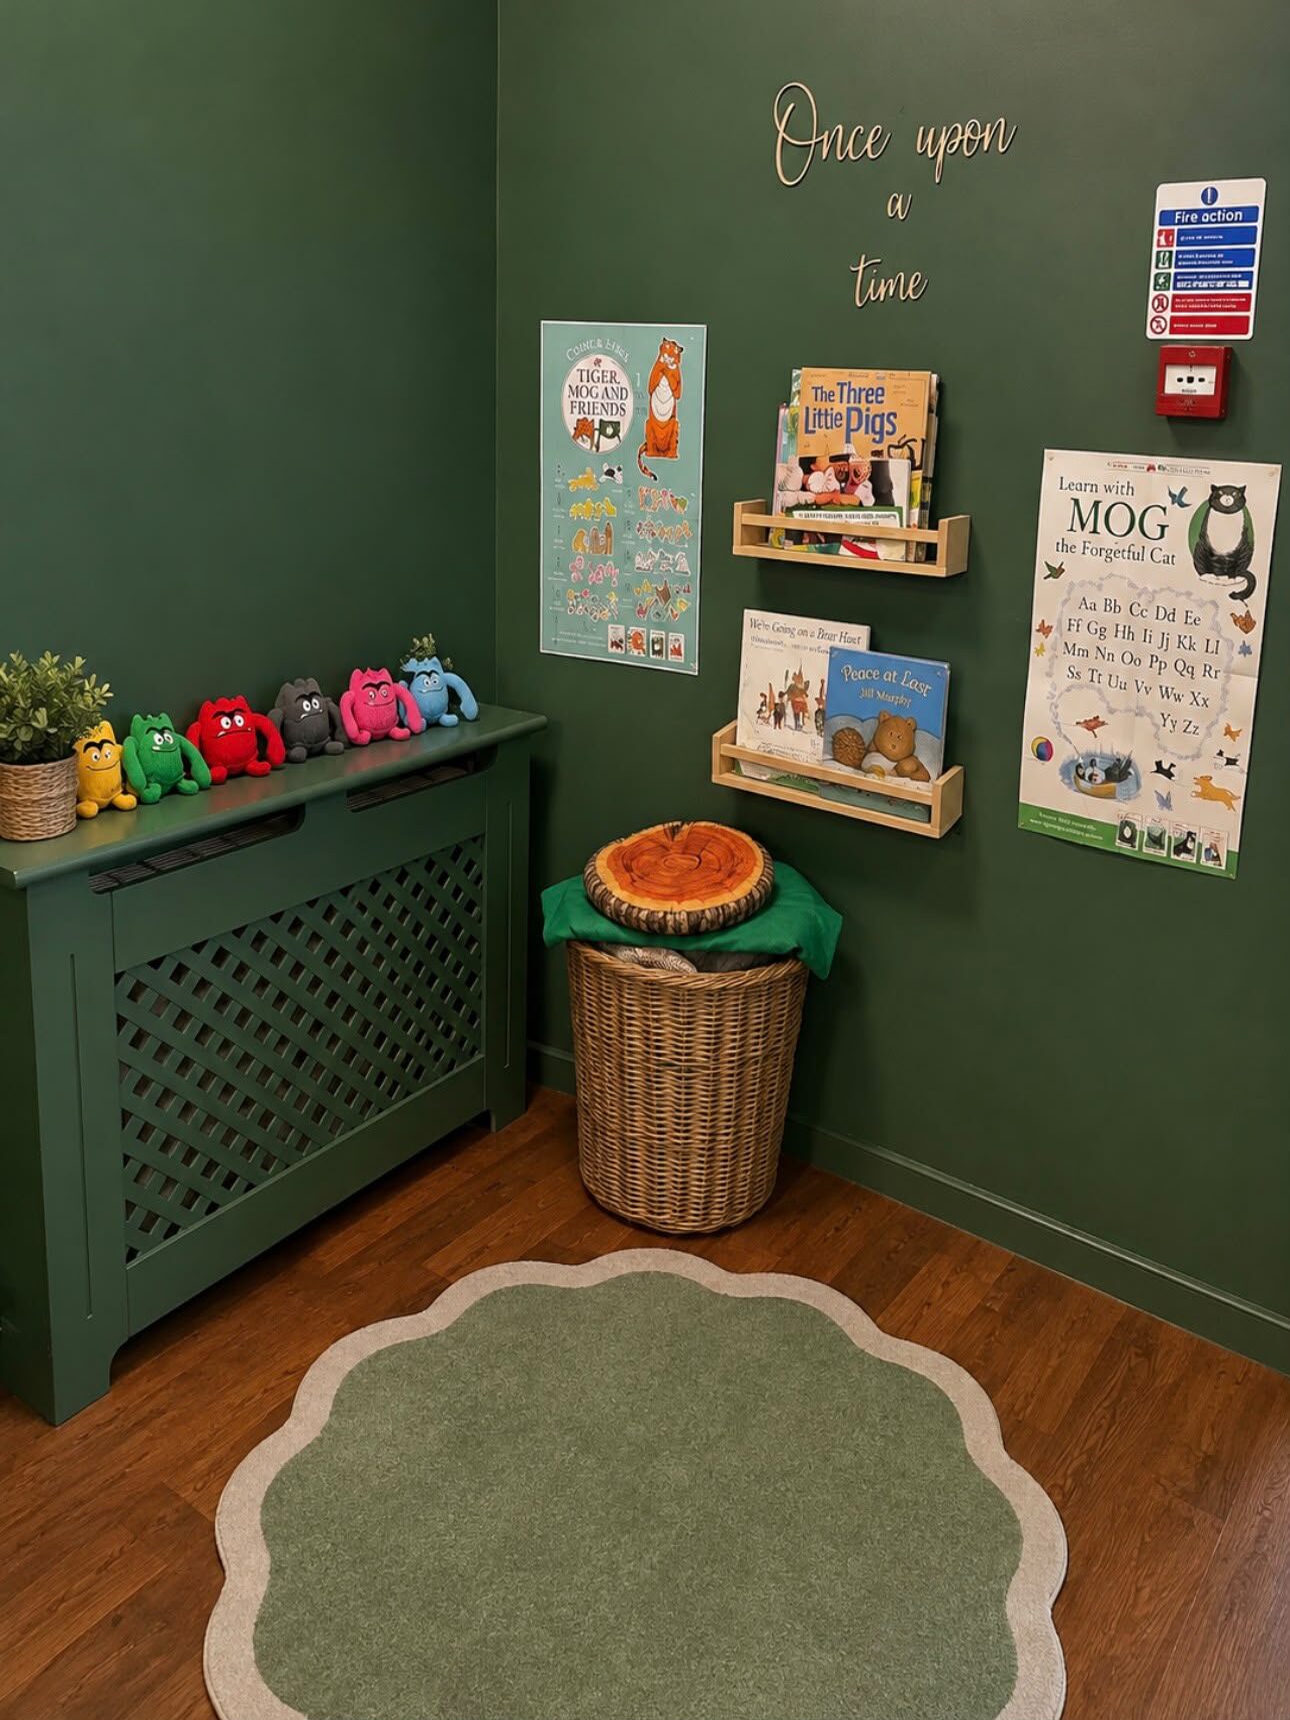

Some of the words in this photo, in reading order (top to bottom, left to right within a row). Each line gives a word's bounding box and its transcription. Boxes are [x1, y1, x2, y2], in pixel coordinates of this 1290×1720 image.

[773, 81, 892, 186] Once
[916, 117, 1018, 184] upon
[887, 192, 912, 220] a
[1175, 211, 1198, 224] Fire
[1201, 209, 1243, 222] action
[850, 254, 928, 307] time
[568, 384, 599, 399] MOG
[601, 386, 629, 400] AND
[811, 385, 835, 402] The
[836, 381, 885, 404] Three
[570, 400, 626, 417] FRIENDS
[804, 406, 843, 434] Little
[845, 406, 897, 444] Pigs
[1059, 476, 1098, 493] Learn
[1104, 481, 1135, 496] with
[1067, 497, 1169, 541] MOG
[1056, 537, 1077, 553] the
[1081, 540, 1145, 563] Forgetful
[1150, 547, 1176, 566] Cat
[1078, 596, 1097, 611] Aa
[1103, 598, 1121, 614] Bb
[1129, 602, 1148, 618] Cc
[1155, 605, 1176, 622] Dd
[1184, 610, 1201, 625] Ee
[771, 621, 796, 639] Going
[797, 628, 808, 637] on
[1067, 618, 1082, 632] Ff
[1087, 620, 1107, 641] Gg
[1114, 623, 1135, 641] Hh
[1143, 628, 1152, 644] Ii
[1157, 632, 1170, 652] Jj
[1176, 635, 1196, 651] Kk
[1205, 638, 1220, 655] Ll
[1063, 641, 1089, 658] Mm
[1095, 646, 1115, 662] Nn
[1121, 650, 1141, 667] Oo
[1149, 654, 1167, 675] Pp
[1174, 658, 1195, 680] Qq
[1202, 663, 1221, 679] Rr
[841, 664, 880, 682] Peace
[883, 670, 898, 683] at
[901, 670, 932, 697] Last
[1066, 665, 1082, 680] Ss
[1088, 667, 1102, 684] Tt
[1107, 674, 1127, 691] Uu
[1134, 679, 1152, 695] Vv
[1158, 685, 1184, 702] Ww
[1189, 691, 1210, 708] Xx
[1160, 712, 1178, 733] Yy
[1182, 719, 1200, 735] Zz
